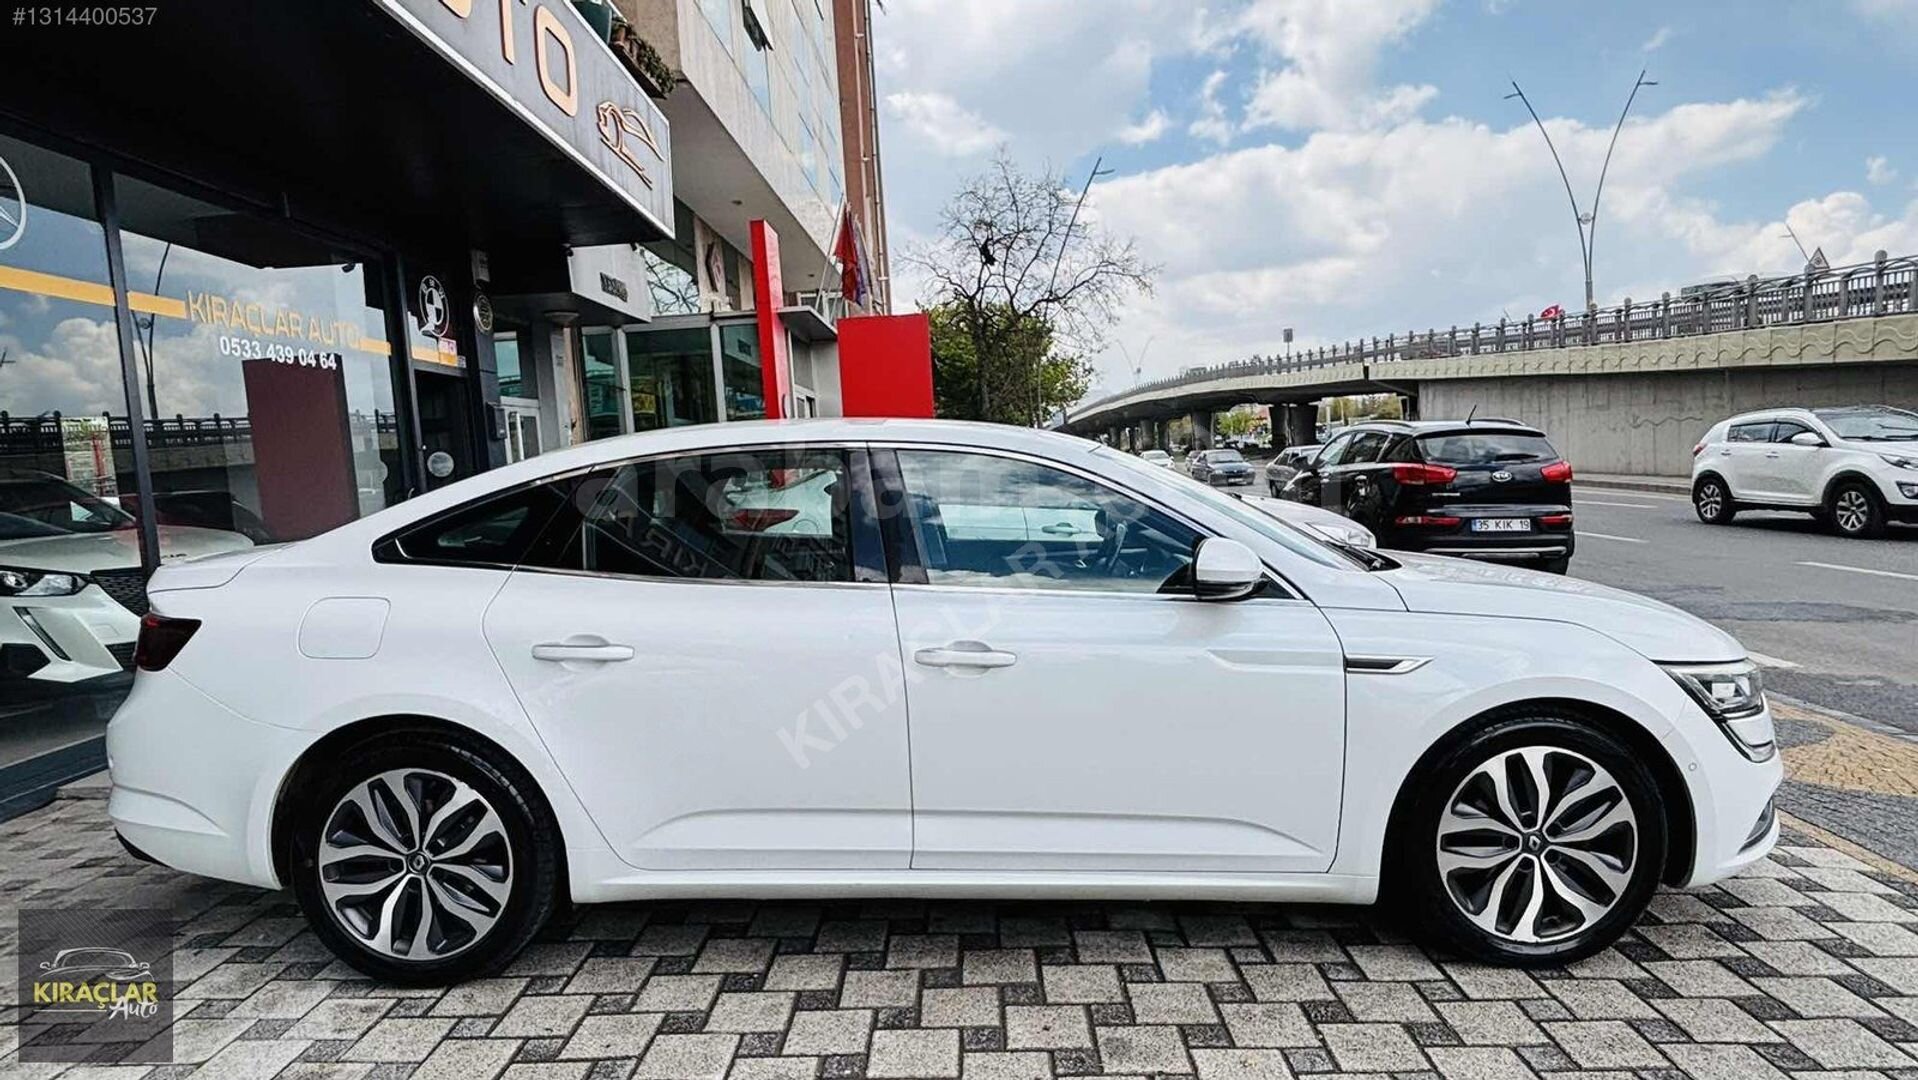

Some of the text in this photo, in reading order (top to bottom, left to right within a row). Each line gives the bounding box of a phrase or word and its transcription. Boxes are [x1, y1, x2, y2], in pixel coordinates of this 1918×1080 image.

[437, 0, 578, 117] TO
[308, 315, 360, 348] AUTO
[219, 335, 337, 371] 0533 439 04 64
[1478, 520, 1489, 530] 35
[1494, 520, 1513, 530] KIK
